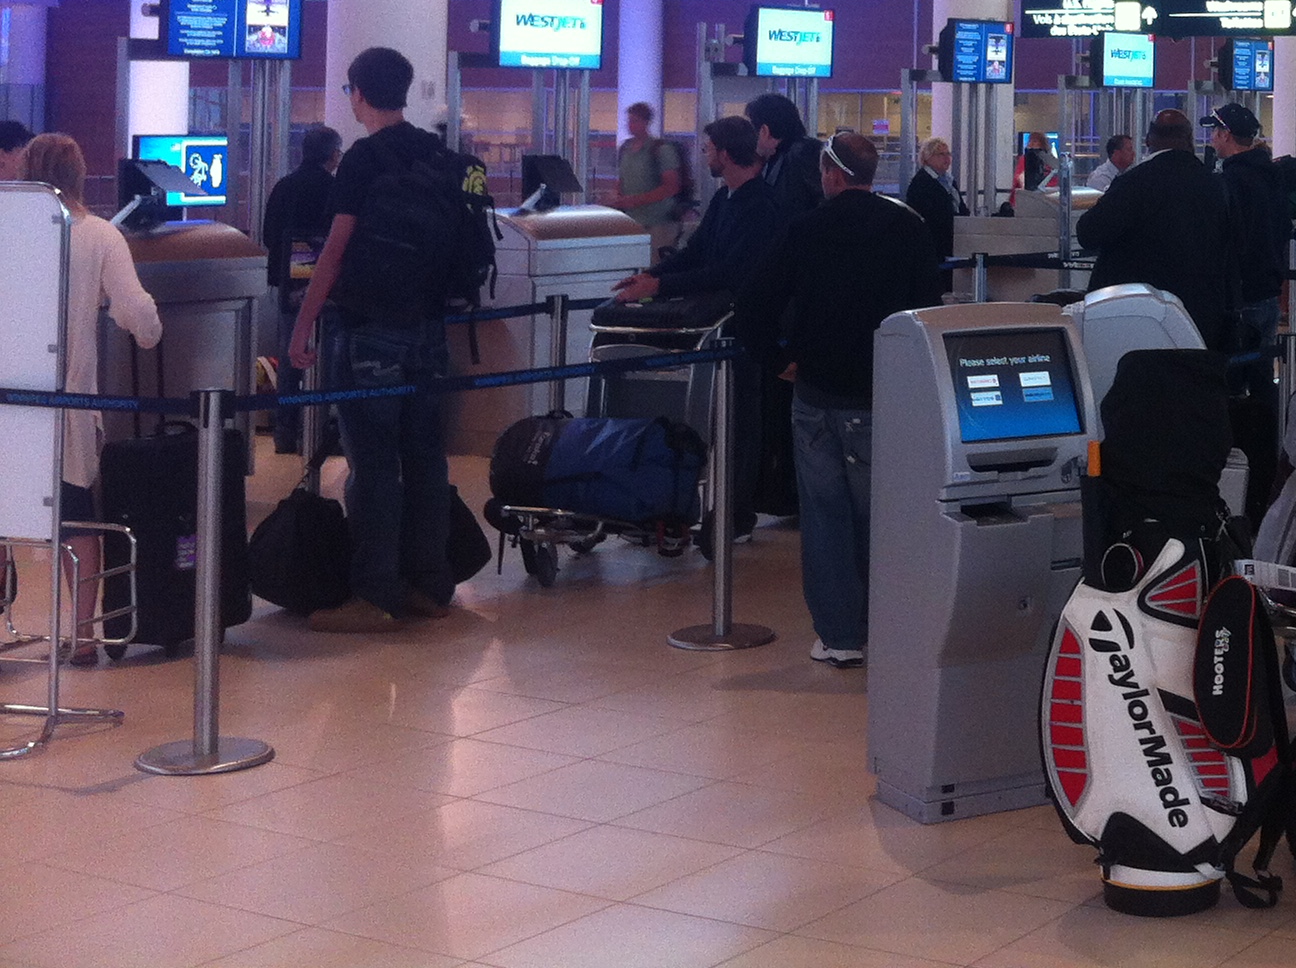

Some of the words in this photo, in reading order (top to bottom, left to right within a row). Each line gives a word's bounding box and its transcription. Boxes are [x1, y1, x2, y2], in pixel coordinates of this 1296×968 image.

[516, 13, 581, 32] WESTJET
[768, 29, 817, 45] WESTJET
[960, 358, 985, 368] Please
[986, 357, 1008, 366] select
[1009, 356, 1026, 366] your
[1028, 354, 1051, 363] airline
[1212, 628, 1226, 696] HOOTERS
[1088, 608, 1191, 829] TaylorMade
